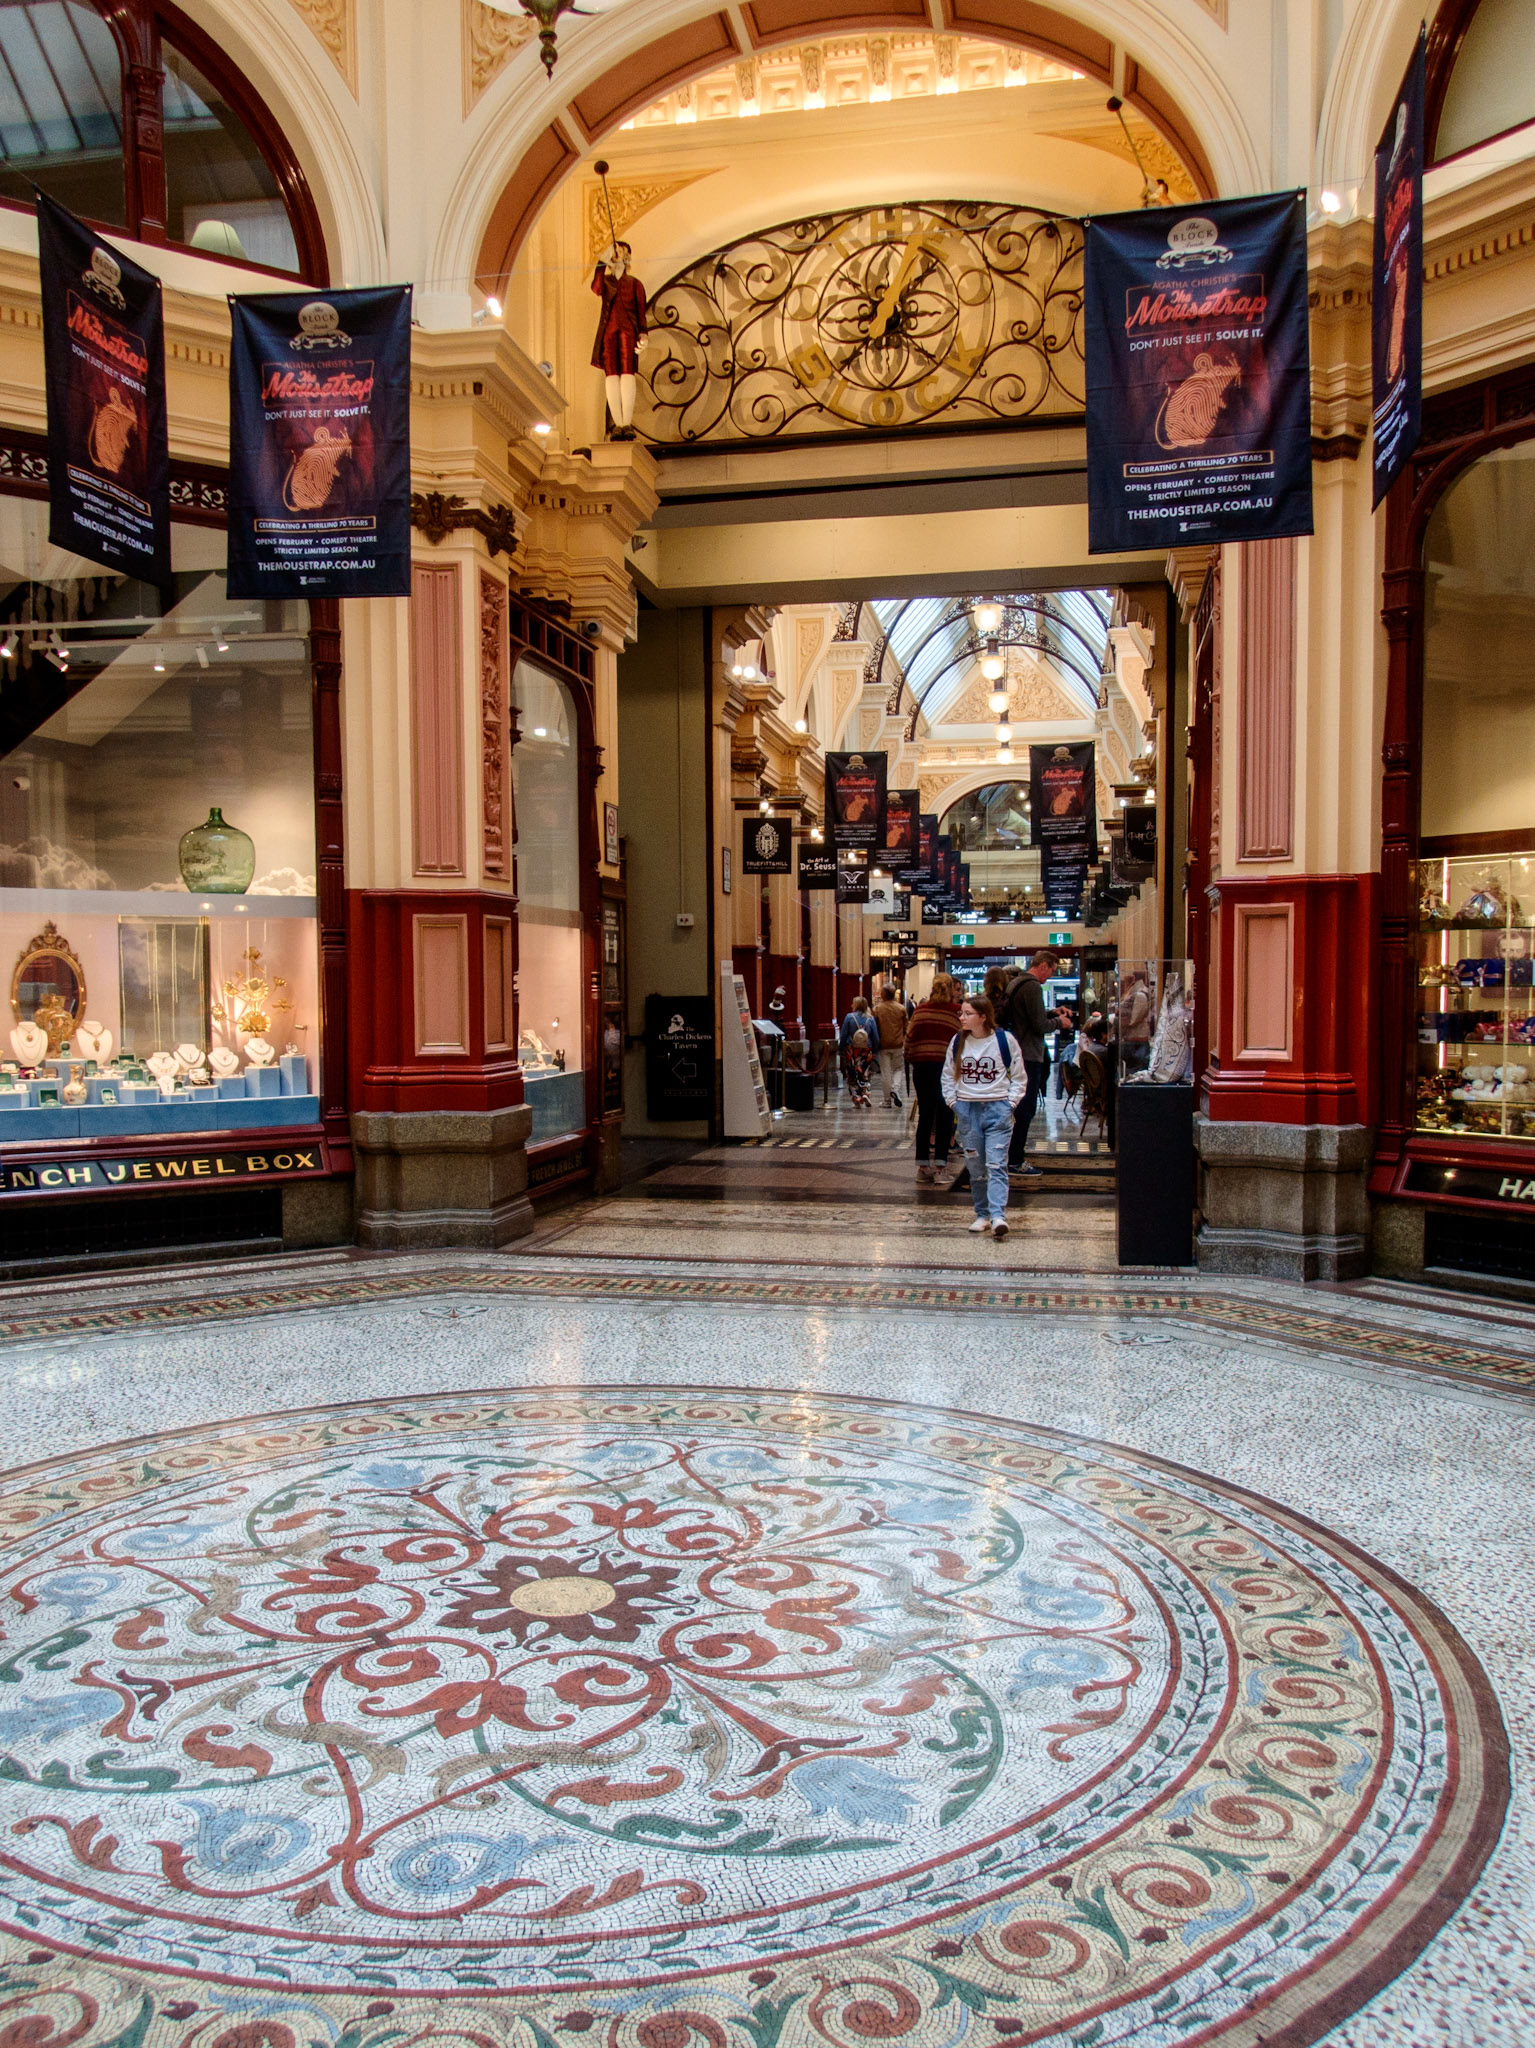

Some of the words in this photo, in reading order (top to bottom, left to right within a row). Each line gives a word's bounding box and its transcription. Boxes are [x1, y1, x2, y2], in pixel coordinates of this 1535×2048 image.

[1173, 230, 1214, 242] BLOCK
[1152, 280, 1188, 290] AGATHA
[1191, 273, 1238, 287] CHRISTIE'S
[1170, 289, 1192, 304] The
[1124, 288, 1267, 329] Mousetrap
[302, 313, 336, 323] BLOCK
[67, 305, 149, 376] Mousetrap
[1129, 338, 1160, 352] DON'T
[1161, 335, 1182, 347] JUST
[1185, 333, 1201, 344] SEE
[1203, 332, 1214, 342] IT.
[1215, 328, 1249, 341] SOLVE
[1251, 328, 1264, 338] IT.
[261, 371, 374, 400] Mousetrap
[265, 410, 288, 421] DON'T
[288, 409, 307, 419] JUST
[309, 409, 322, 418] SEE
[323, 409, 332, 418] IT.
[334, 407, 359, 418] SOLVE
[360, 405, 371, 414] IT.
[1129, 463, 1177, 474] CELEBRATING
[1187, 458, 1226, 469] THRILLING
[1227, 456, 1238, 464] 70
[1239, 454, 1263, 463] YEARS
[1124, 484, 1151, 492] OPENS
[1153, 479, 1194, 491] FEBRUARY
[1204, 473, 1239, 484] COMEDY
[1240, 471, 1275, 481] THEATRE
[1148, 491, 1182, 502] STRICTLY
[1184, 487, 1216, 497] LIMITED
[1217, 484, 1251, 494] SEASON
[1127, 498, 1273, 521] THEMOUSETRAP.COM.AU
[258, 521, 300, 530] CELEBRATING
[308, 521, 338, 529] THRILLING
[278, 538, 313, 546] FEBRUARY
[321, 537, 348, 545] COMEDY
[349, 535, 377, 543] THEATRE
[274, 547, 303, 555] STRICTLY
[258, 559, 376, 571] THEMOUSETRAP.COM.AU
[800, 862, 812, 870] Dr.
[814, 862, 836, 870] Seuss
[672, 1041, 698, 1049] Tavern
[962, 1057, 996, 1084] 23
[106, 1158, 236, 1184] JEWEL
[246, 1152, 315, 1172] BOX
